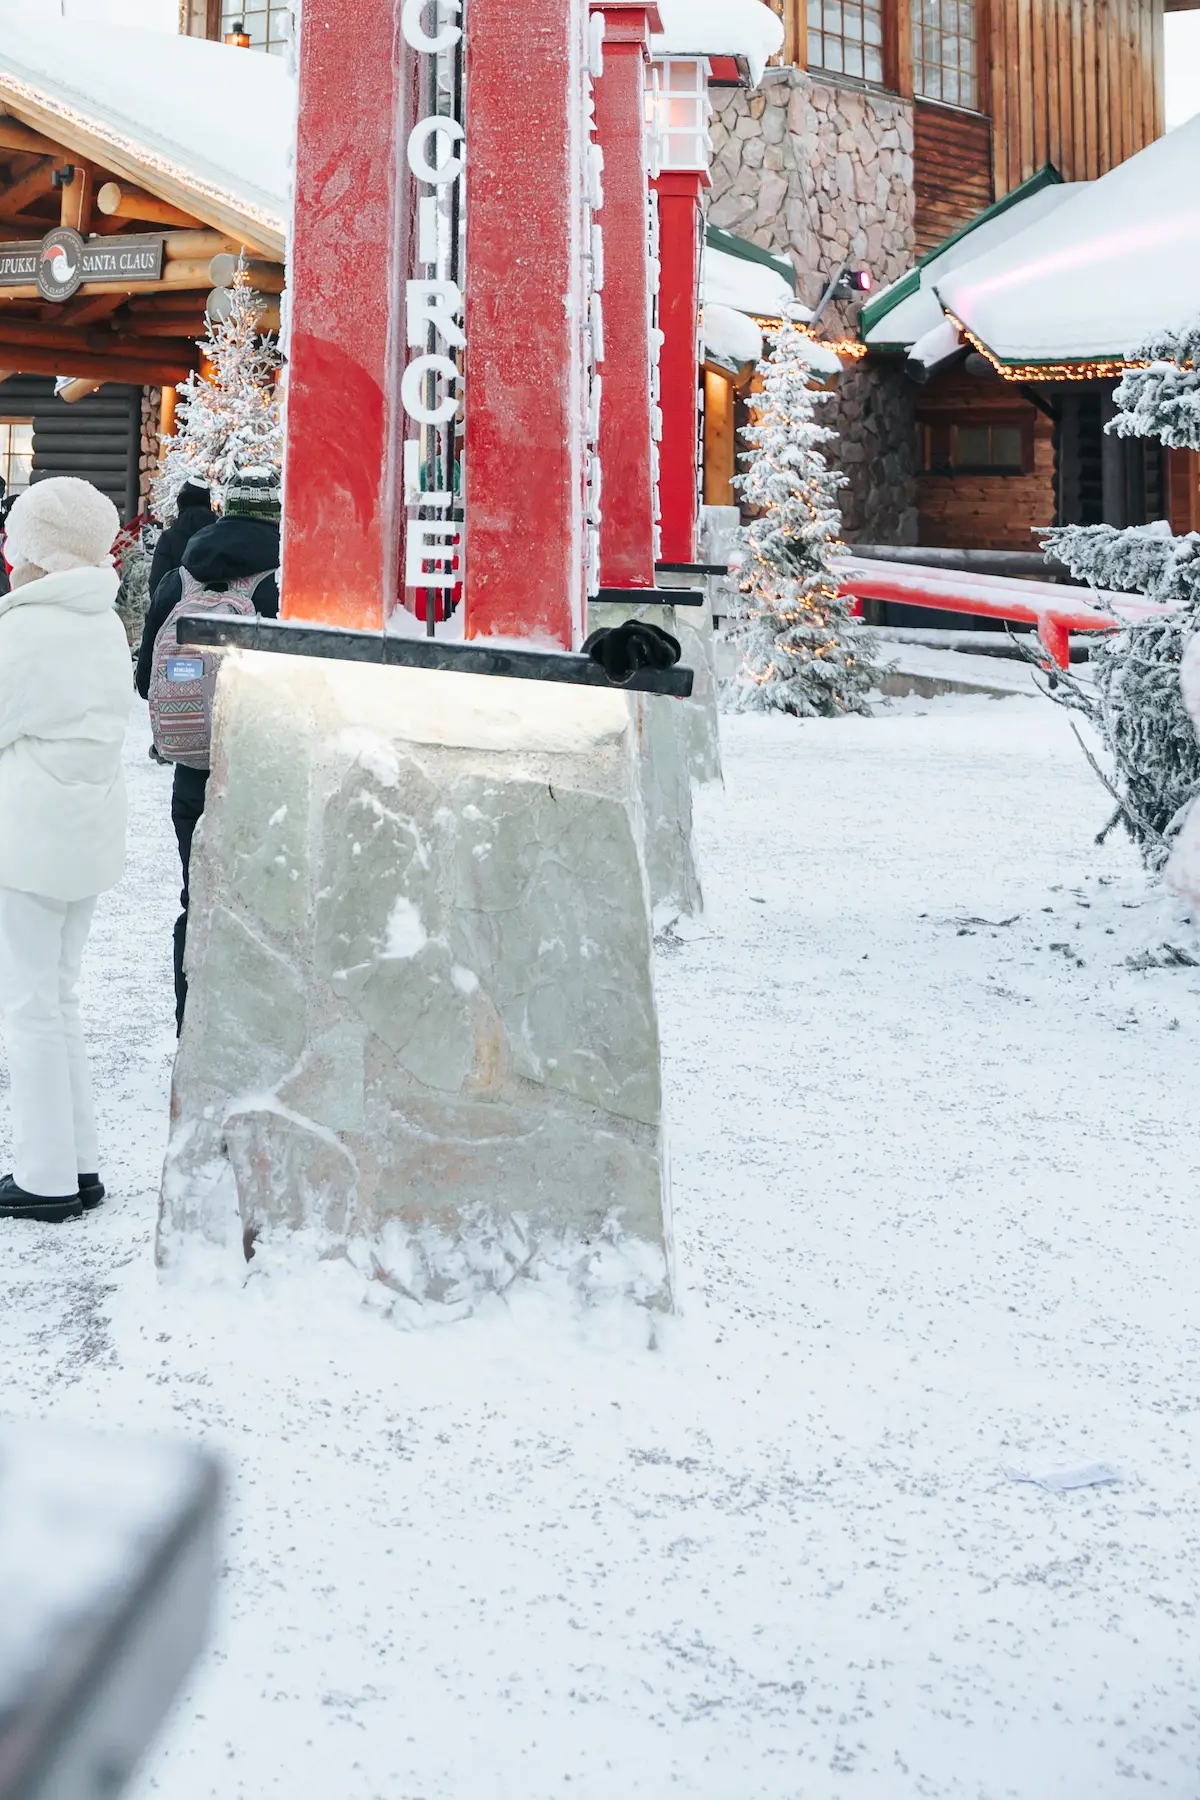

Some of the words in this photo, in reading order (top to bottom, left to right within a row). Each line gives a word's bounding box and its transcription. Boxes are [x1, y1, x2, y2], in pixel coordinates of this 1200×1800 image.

[82, 254, 117, 271] SANTA
[120, 253, 155, 270] CLAUS
[400, 115, 467, 589] CIRCLE
